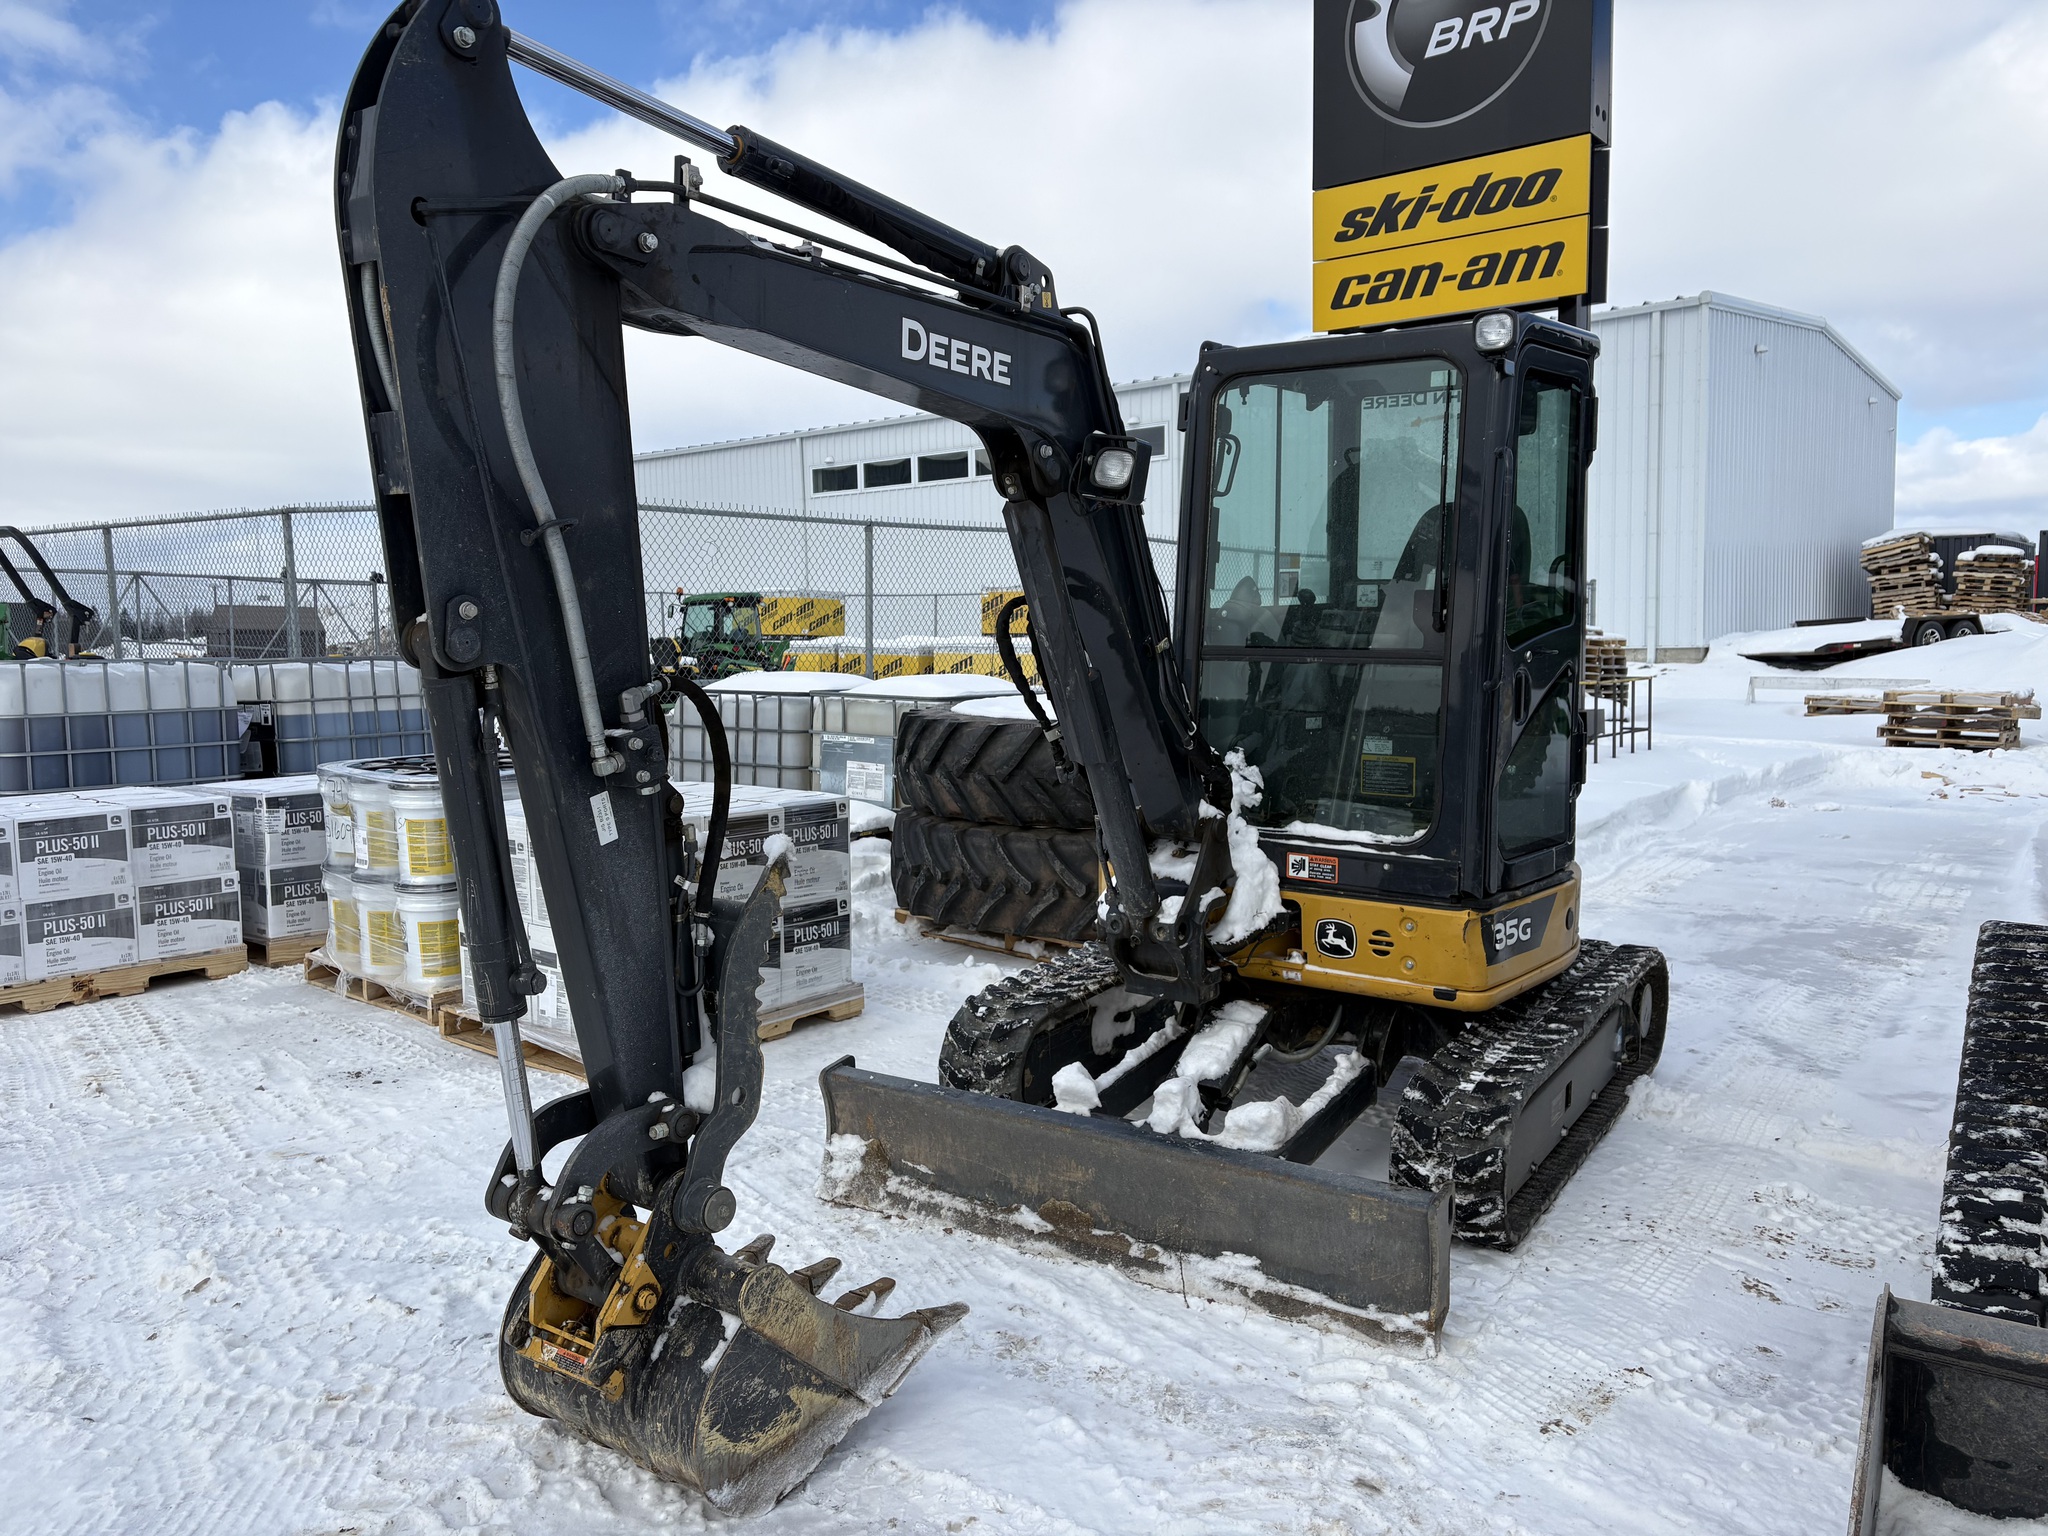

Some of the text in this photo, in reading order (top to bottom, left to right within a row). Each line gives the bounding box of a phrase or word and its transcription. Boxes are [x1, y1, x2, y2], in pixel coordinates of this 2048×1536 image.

[1424, 0, 1540, 58] BRP
[1334, 168, 1562, 242] ski-doo
[1330, 241, 1565, 310] can-am
[902, 317, 1011, 385] DEERE
[286, 811, 322, 826] LUS-50
[147, 822, 206, 840] PLUS-50 II
[792, 823, 838, 843] PLUS-50 II
[36, 835, 99, 854] PLUS-50 II
[732, 838, 761, 856] US-50
[38, 855, 72, 865] SAE 15W-40
[155, 897, 213, 917] PLUS-50 II
[43, 914, 106, 935] PLUS-50 II
[170, 917, 190, 925] 15W-40
[59, 935, 80, 944] 15W-40
[794, 921, 840, 943] PLUS-50 II
[1494, 917, 1532, 950] 35G
